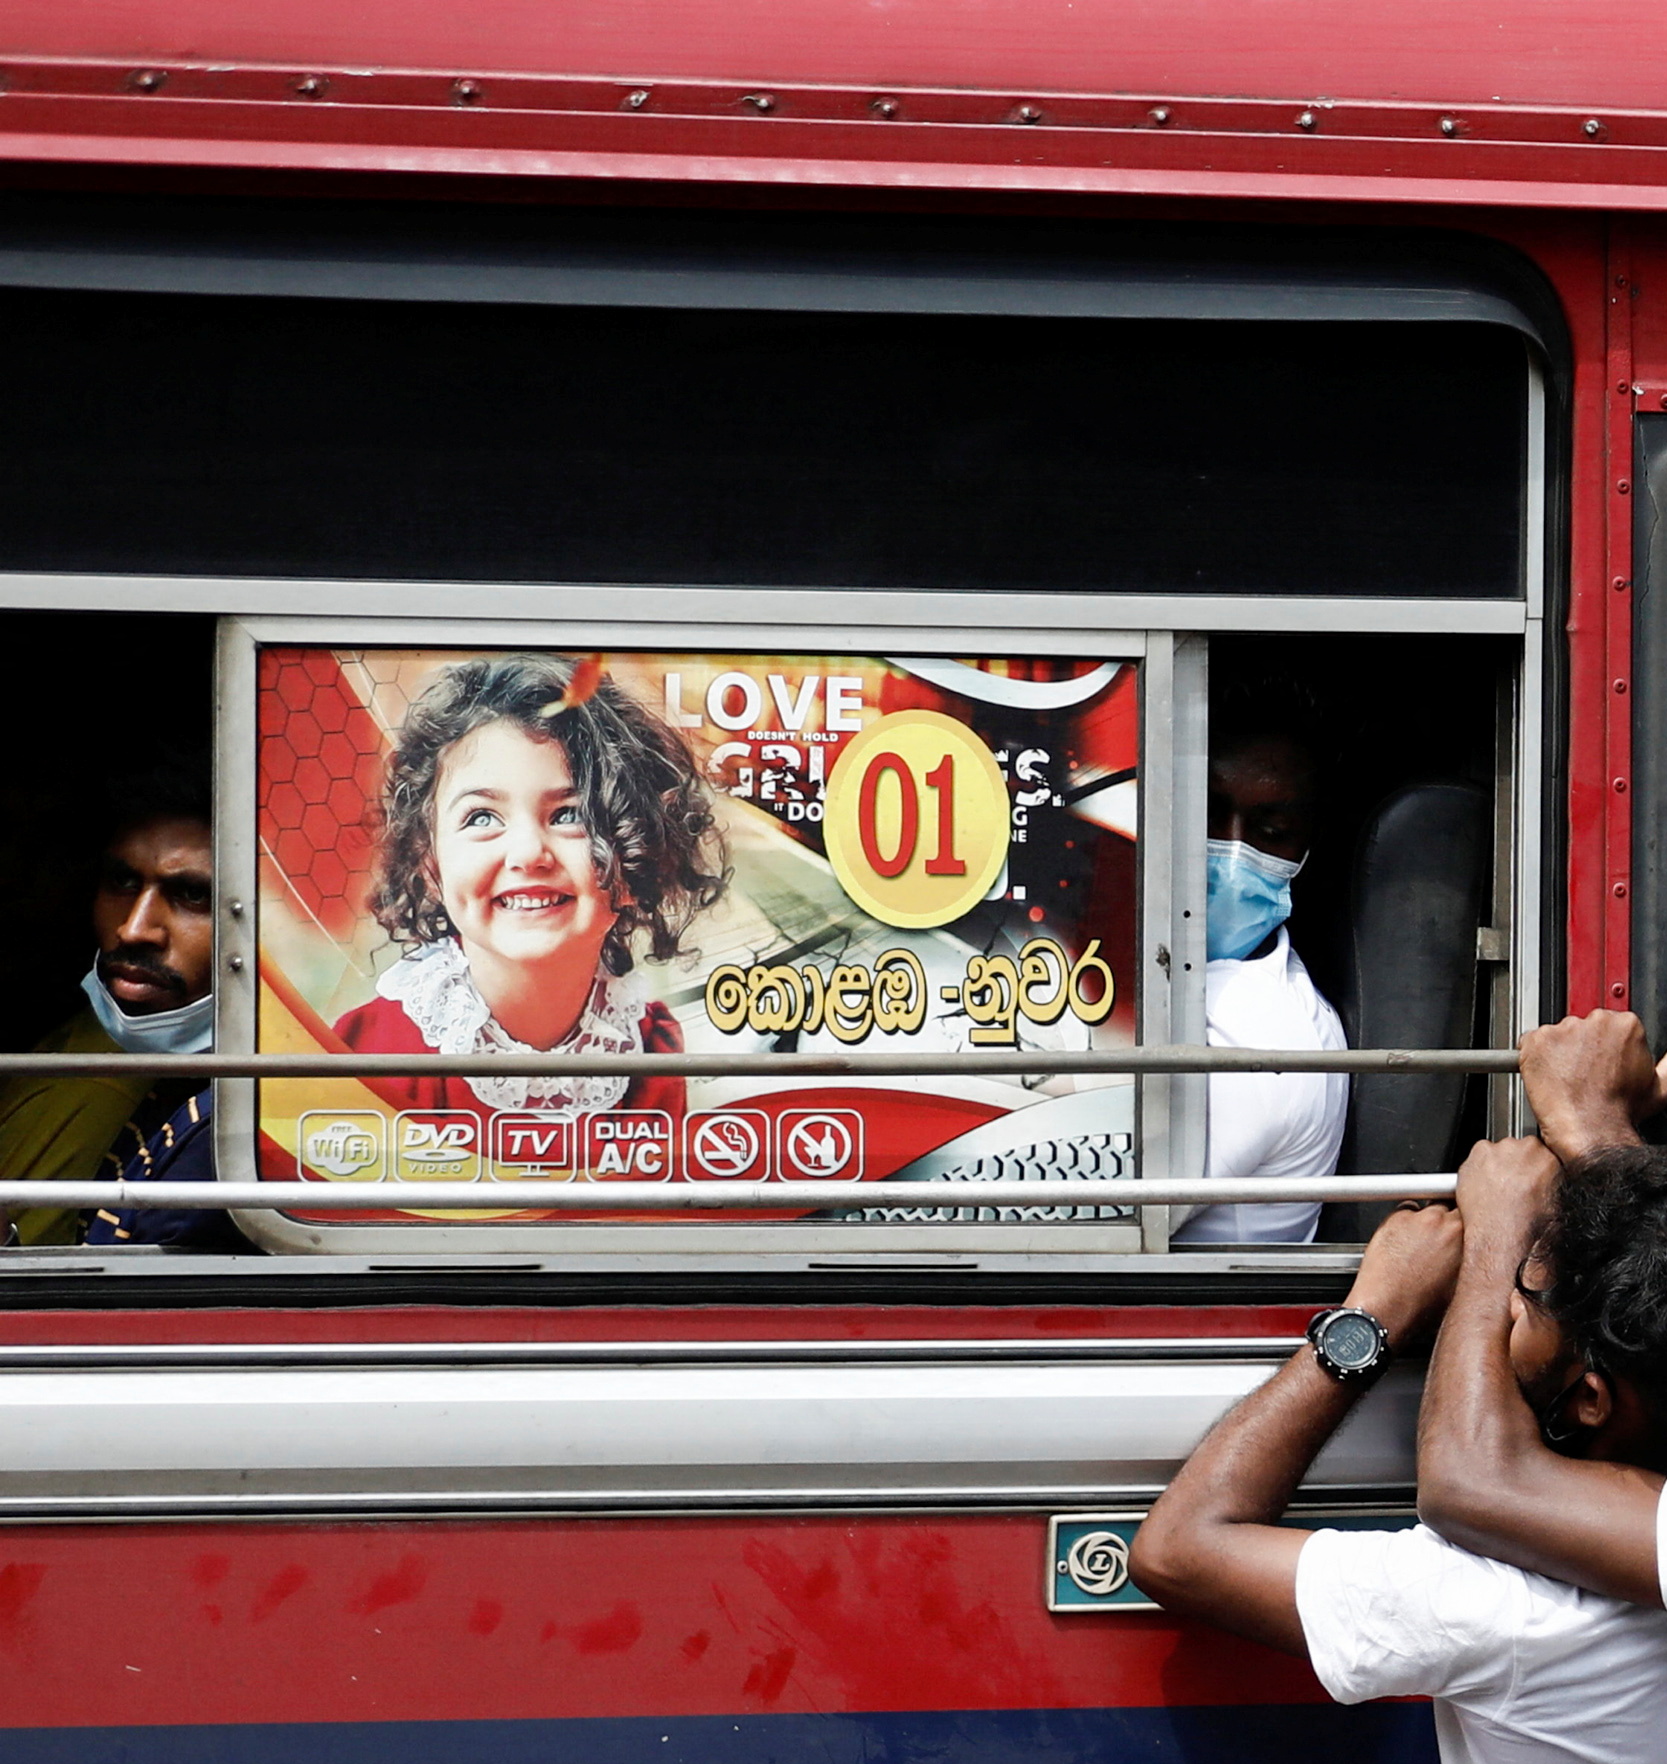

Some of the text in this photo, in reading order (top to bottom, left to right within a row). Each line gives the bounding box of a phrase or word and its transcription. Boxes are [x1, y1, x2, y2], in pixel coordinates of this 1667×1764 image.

[664, 672, 864, 732] LOVE
[747, 730, 839, 742] DOESN'T HOLD
[858, 751, 966, 877] 01
[403, 1123, 476, 1149] DVD
[507, 1129, 559, 1156] TV
[594, 1121, 669, 1140] DUAL
[409, 1162, 463, 1174] VIDEO
[596, 1142, 663, 1175] A/C
